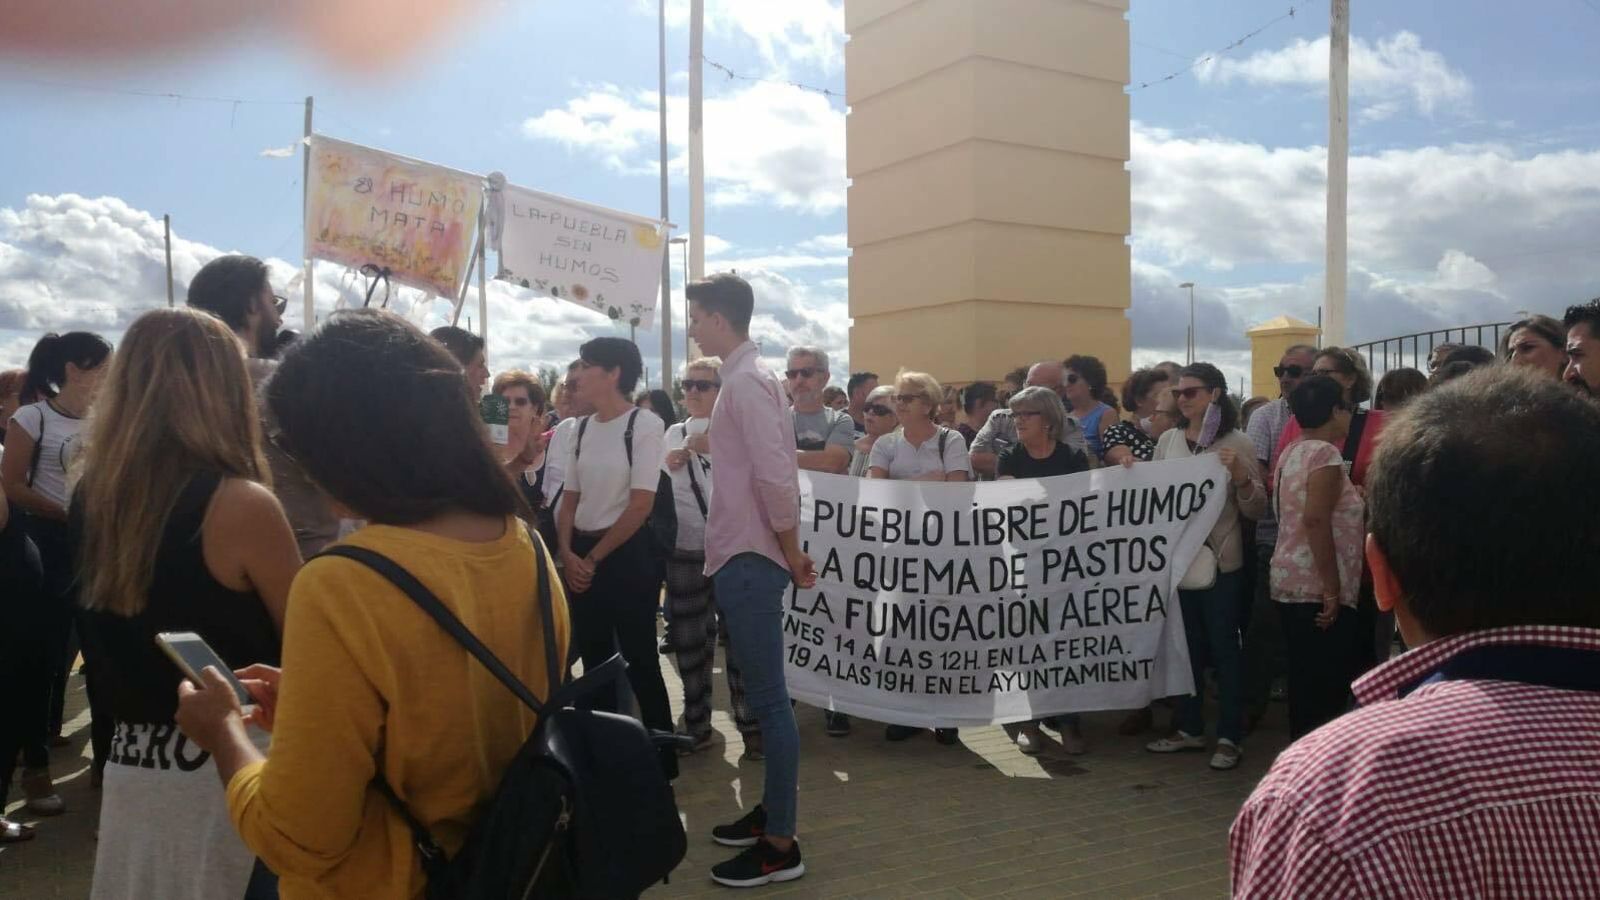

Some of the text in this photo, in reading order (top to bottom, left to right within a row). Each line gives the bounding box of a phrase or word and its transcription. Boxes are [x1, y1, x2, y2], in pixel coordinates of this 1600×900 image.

[390, 180, 464, 214] HUMO
[370, 206, 445, 236] MATA
[553, 236, 592, 252] SIN
[540, 253, 619, 283] HUMOS
[813, 499, 943, 547] PUEBLO
[1058, 494, 1098, 536] DE
[1106, 479, 1214, 527] HUMOS
[853, 552, 980, 595] QUEMA
[989, 553, 1028, 592] DE
[1042, 535, 1168, 584] PASTOS
[791, 583, 834, 624] LA
[1060, 582, 1167, 630] AÉREA
[787, 643, 811, 668] 19
[813, 654, 832, 676] A
[836, 660, 871, 686] LAS
[925, 676, 952, 694] EN
[959, 675, 982, 694] EL
[988, 659, 1155, 692] AYUNTAMIENT
[834, 634, 855, 656] 14
[863, 644, 877, 662] A
[885, 646, 933, 669] LAS
[988, 647, 1012, 668] EN
[1019, 644, 1047, 664] LA
[1055, 635, 1131, 660] FERIA.
